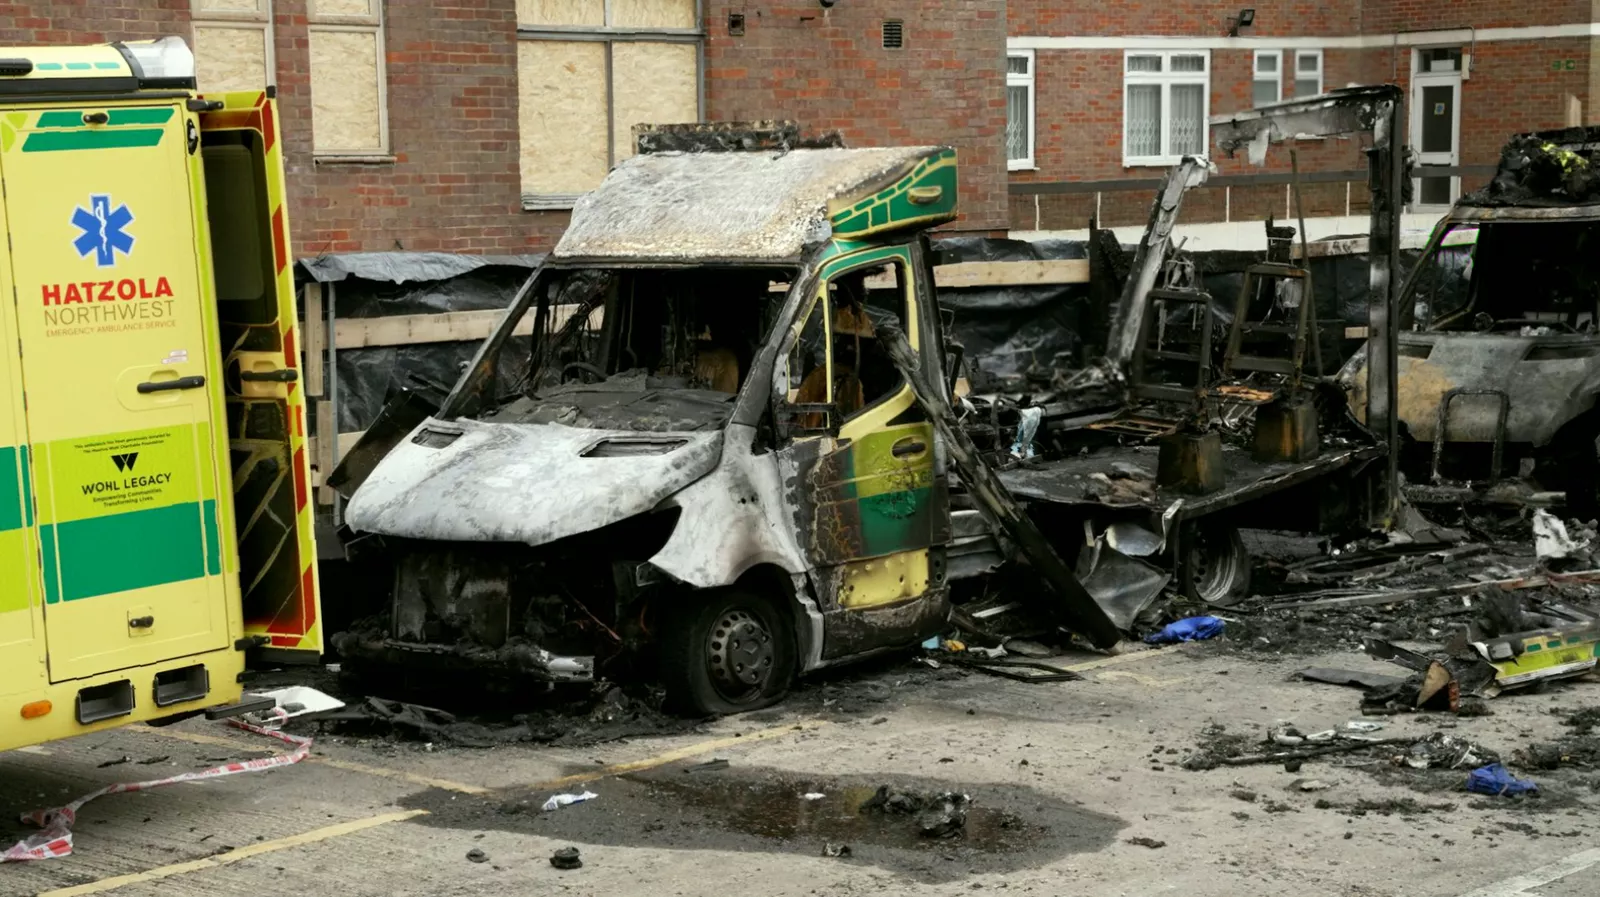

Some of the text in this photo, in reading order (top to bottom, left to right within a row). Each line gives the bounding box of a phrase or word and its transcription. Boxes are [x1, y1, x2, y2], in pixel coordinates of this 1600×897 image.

[42, 277, 174, 306] HATZOLA
[44, 300, 174, 326] NORTHWEST
[46, 320, 176, 338] EMERGENCY AMBULANCE SERVICE
[81, 472, 172, 495] WOHL LEGACY
[93, 493, 127, 503] Empowering
[103, 498, 138, 508] Transforming
